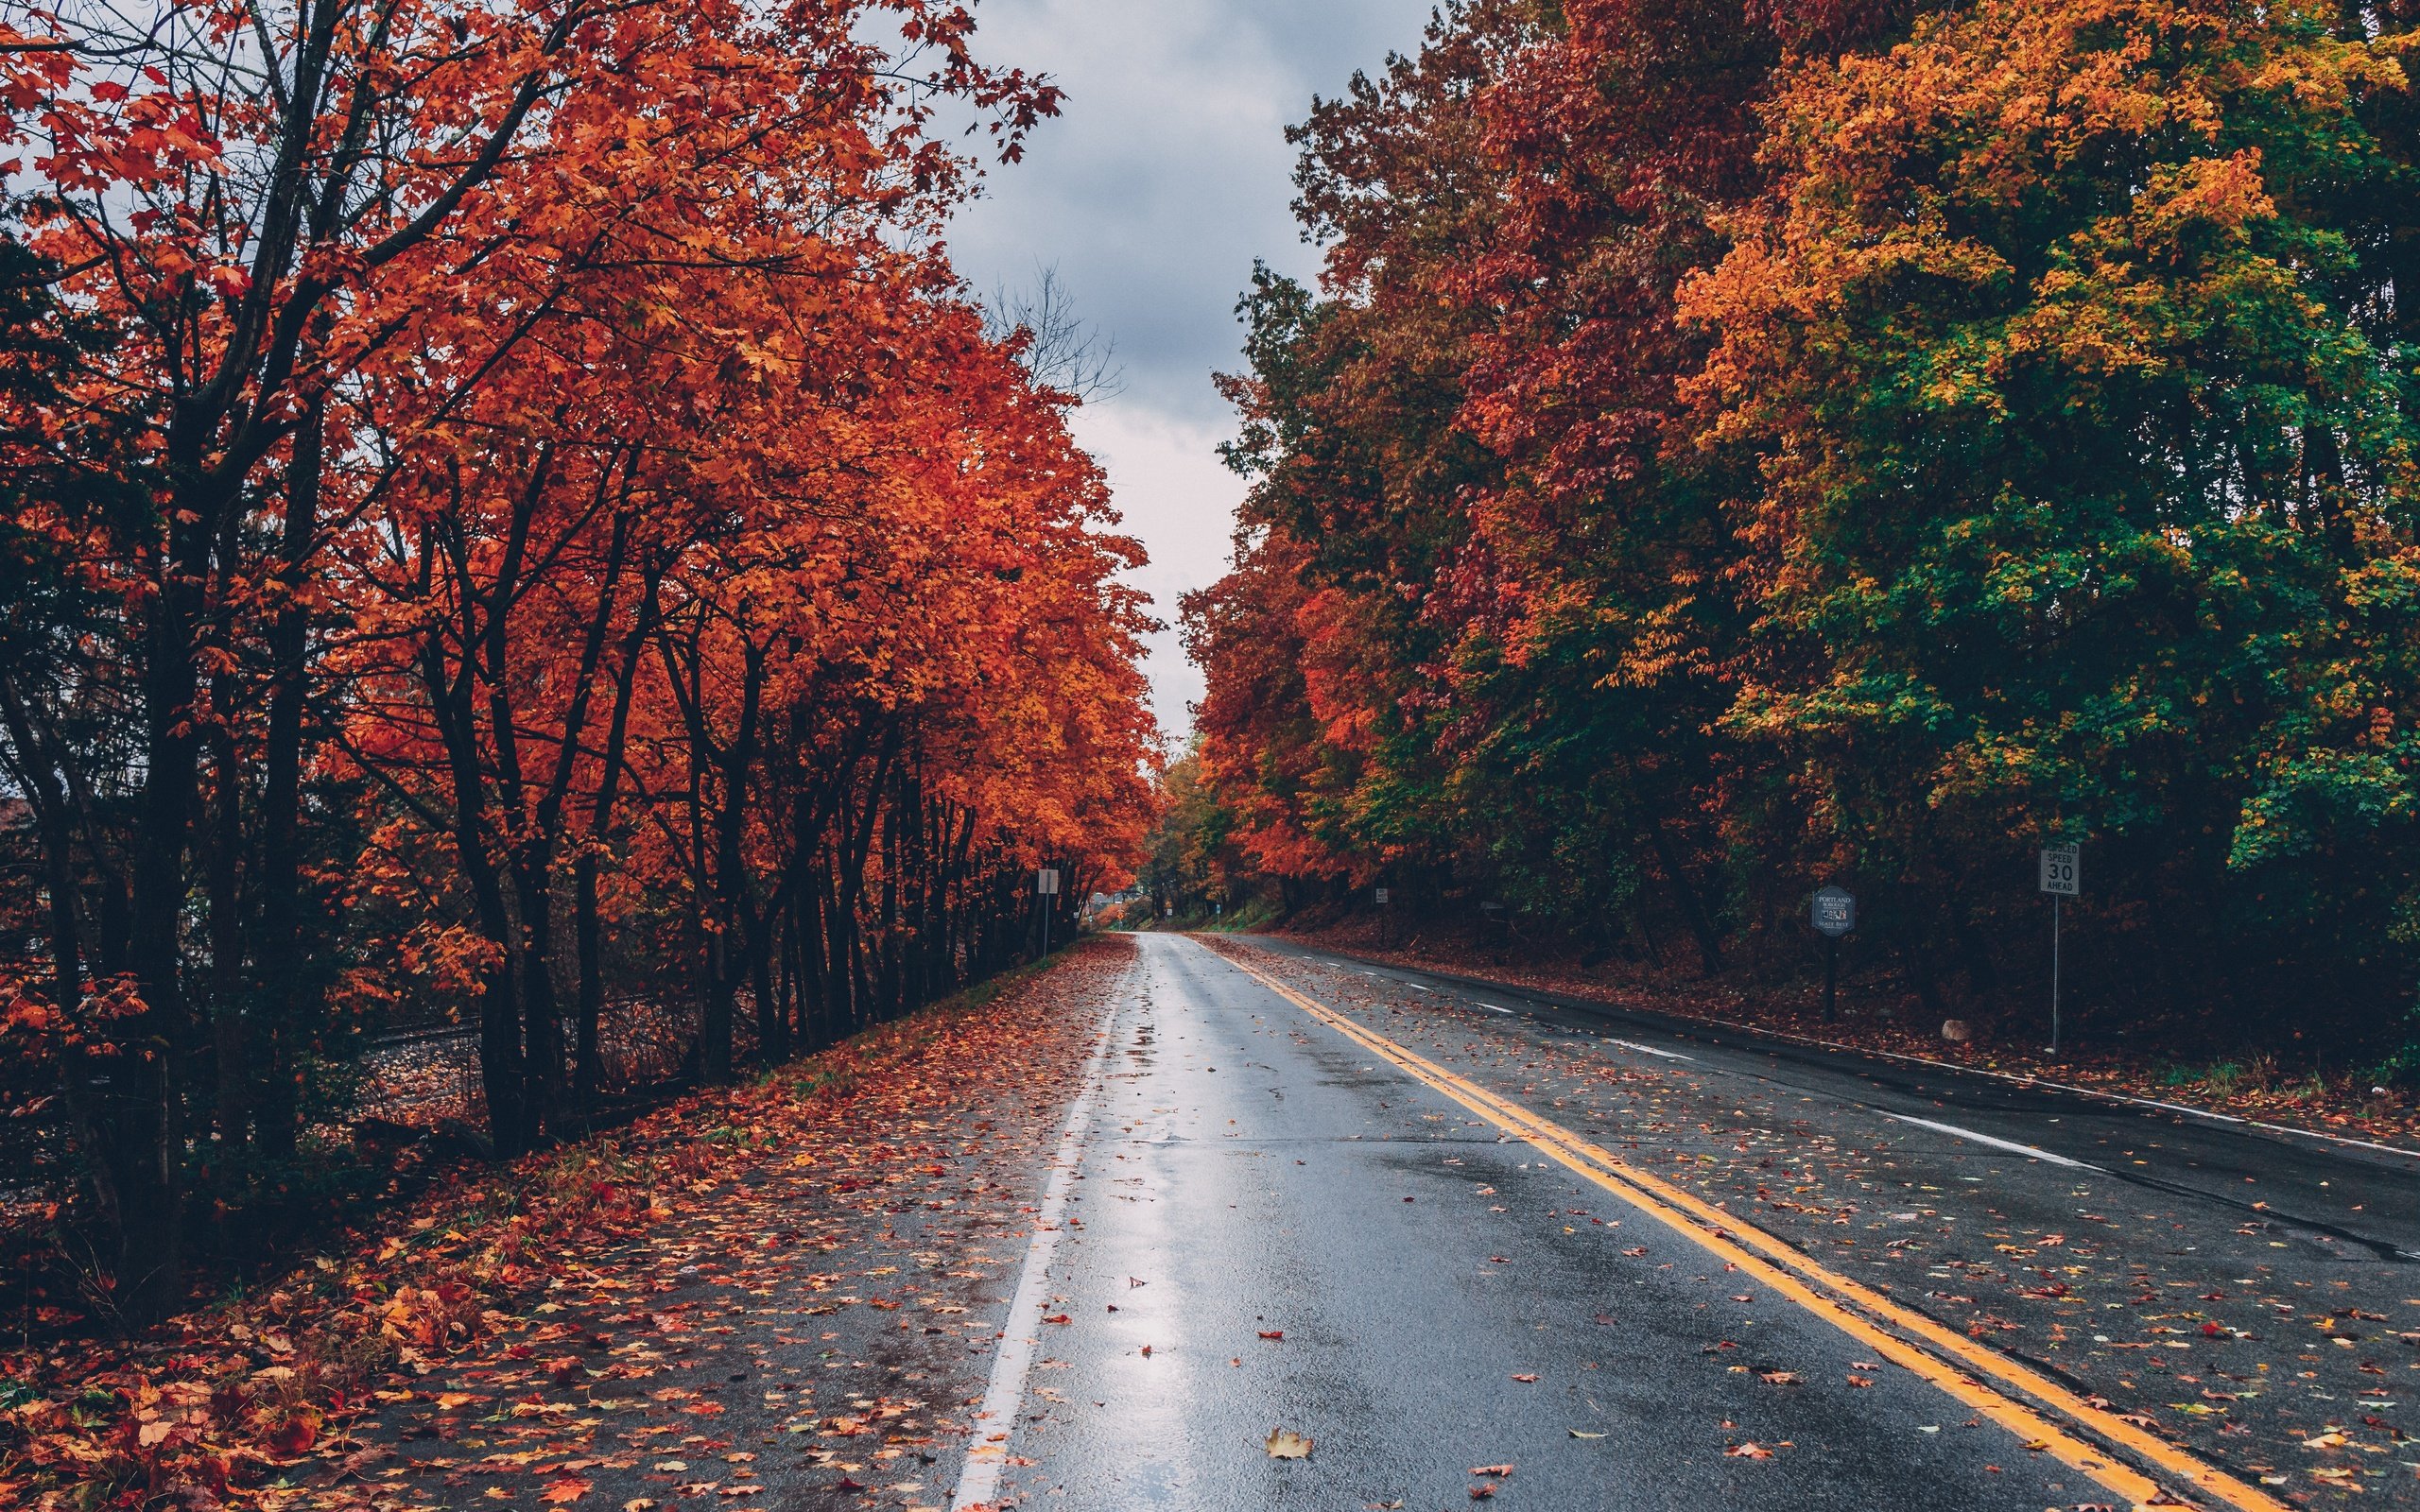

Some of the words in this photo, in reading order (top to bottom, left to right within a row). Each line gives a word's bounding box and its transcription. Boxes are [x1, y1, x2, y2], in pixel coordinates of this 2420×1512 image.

[2048, 852, 2072, 864] SPEED
[2048, 863, 2073, 881] 30
[2047, 881, 2073, 891] AHEAD
